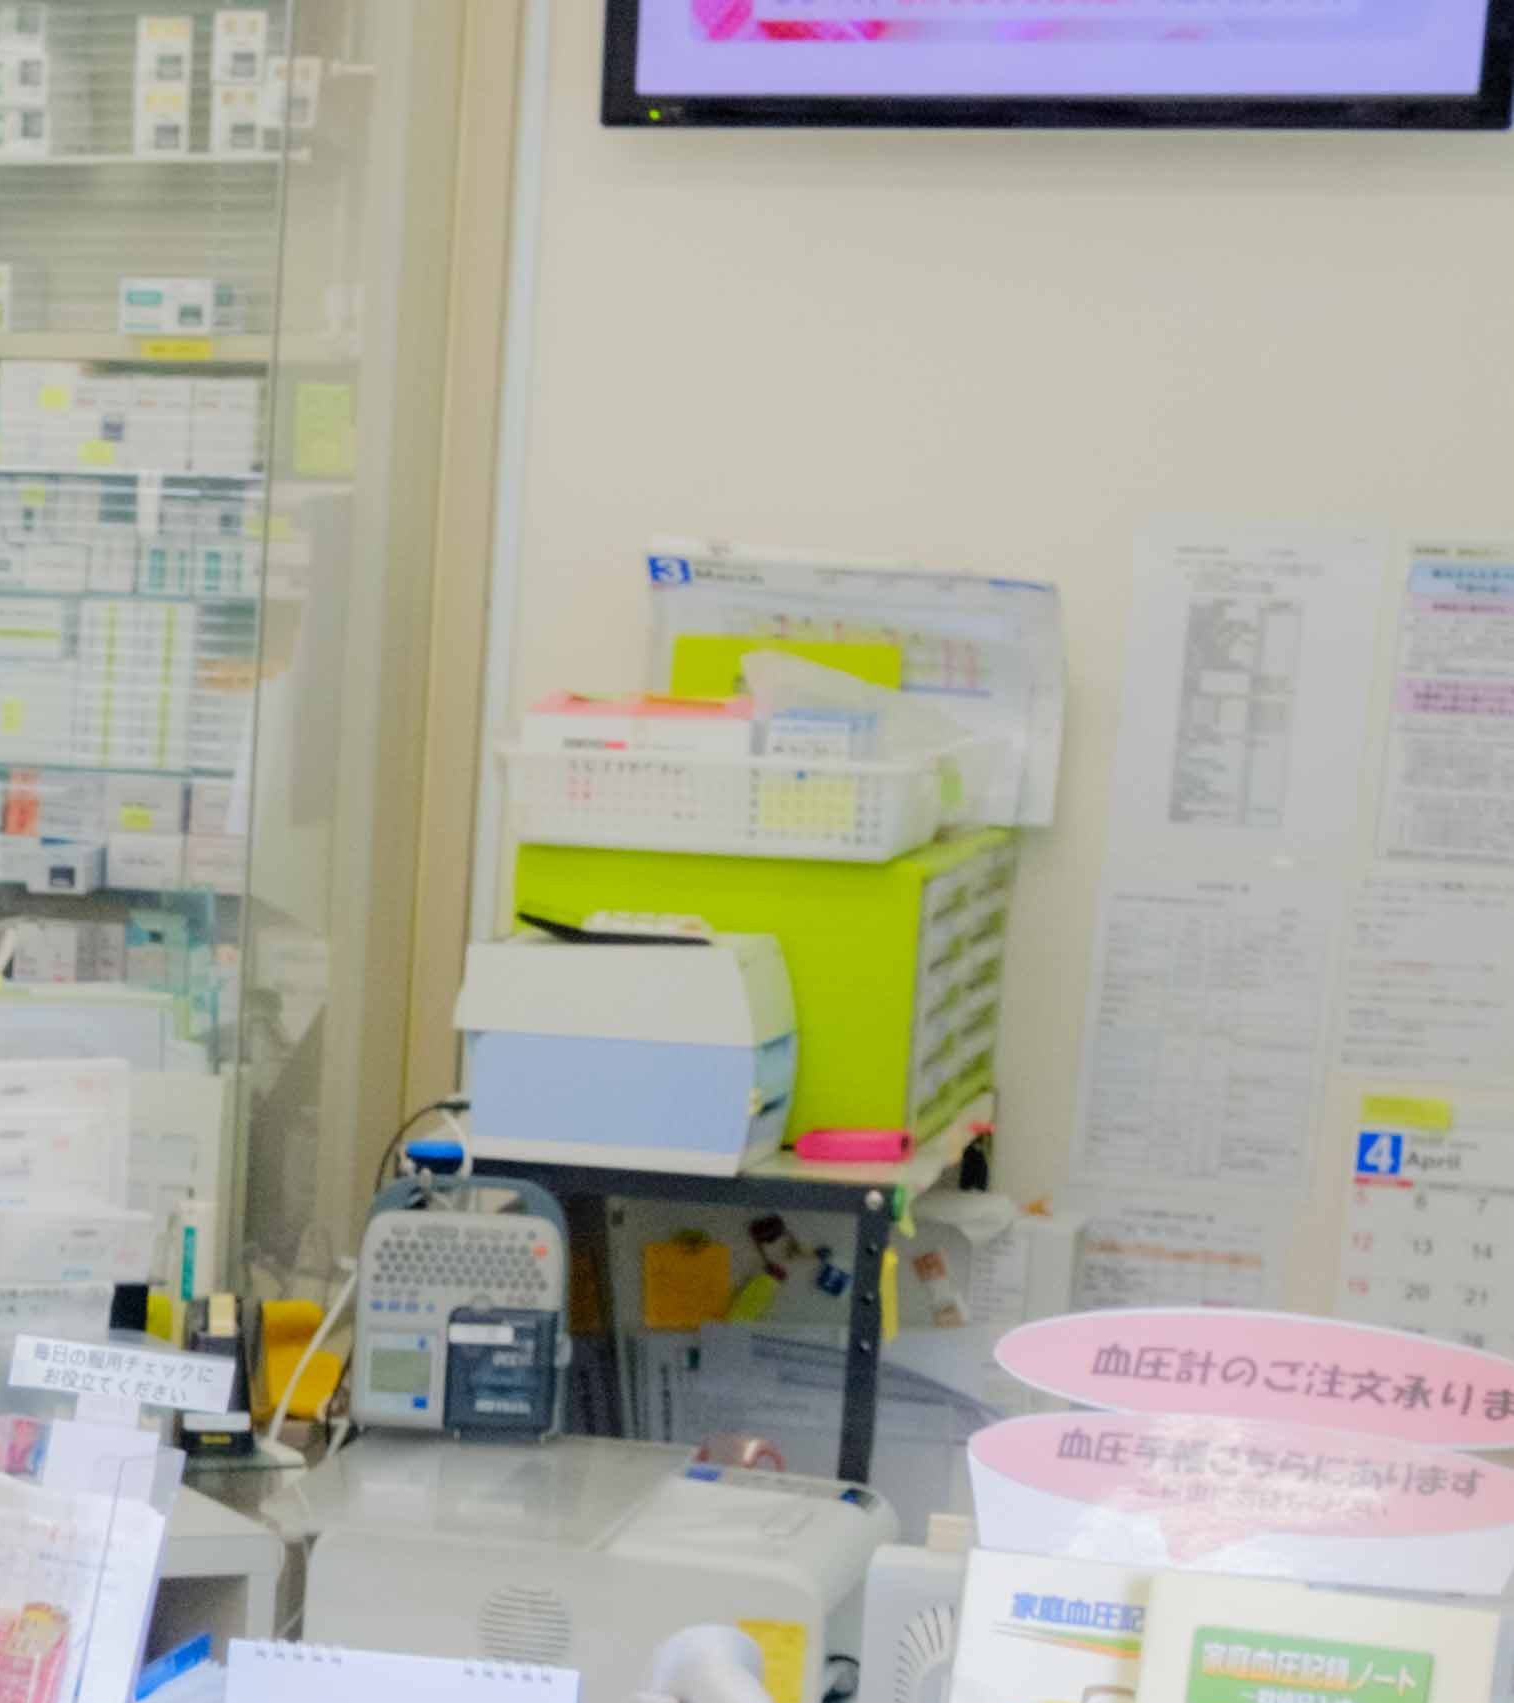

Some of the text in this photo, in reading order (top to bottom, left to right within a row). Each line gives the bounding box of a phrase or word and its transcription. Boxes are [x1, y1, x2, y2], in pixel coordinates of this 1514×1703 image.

[656, 558, 687, 586] 3
[1364, 1133, 1462, 1174] 4 April
